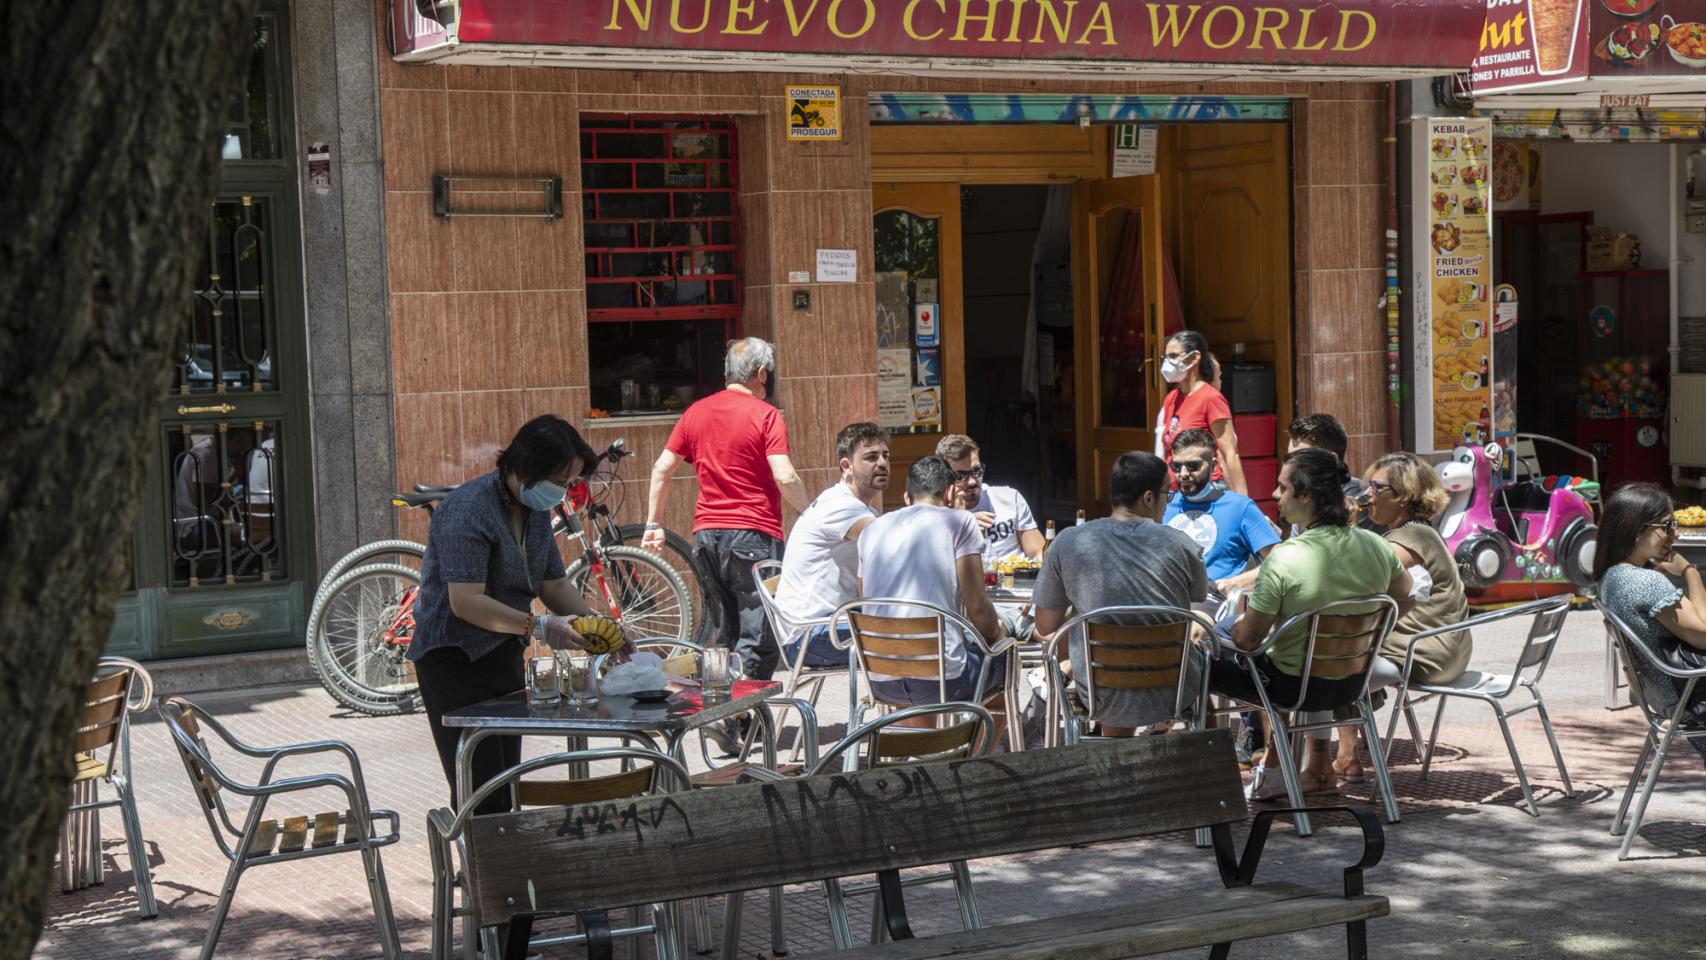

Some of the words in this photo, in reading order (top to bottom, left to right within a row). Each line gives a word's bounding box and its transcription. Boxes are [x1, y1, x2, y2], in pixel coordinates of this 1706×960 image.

[603, 0, 877, 39] NUEVO
[902, 0, 1119, 45] CHINA
[1145, 3, 1377, 51] WORLD
[1479, 49, 1531, 67] RESTAURANTE
[1494, 69, 1501, 79] Y
[1501, 64, 1535, 79] PARRILLA
[790, 88, 836, 96] CONECTADA
[1601, 95, 1627, 107] JUST
[1628, 94, 1649, 106] EAT
[791, 128, 838, 136] PROSEGUR
[1433, 125, 1466, 134] KEBAB
[1117, 123, 1139, 148] H
[1436, 257, 1464, 266] FRIED
[1436, 268, 1479, 276] CHICKEN
